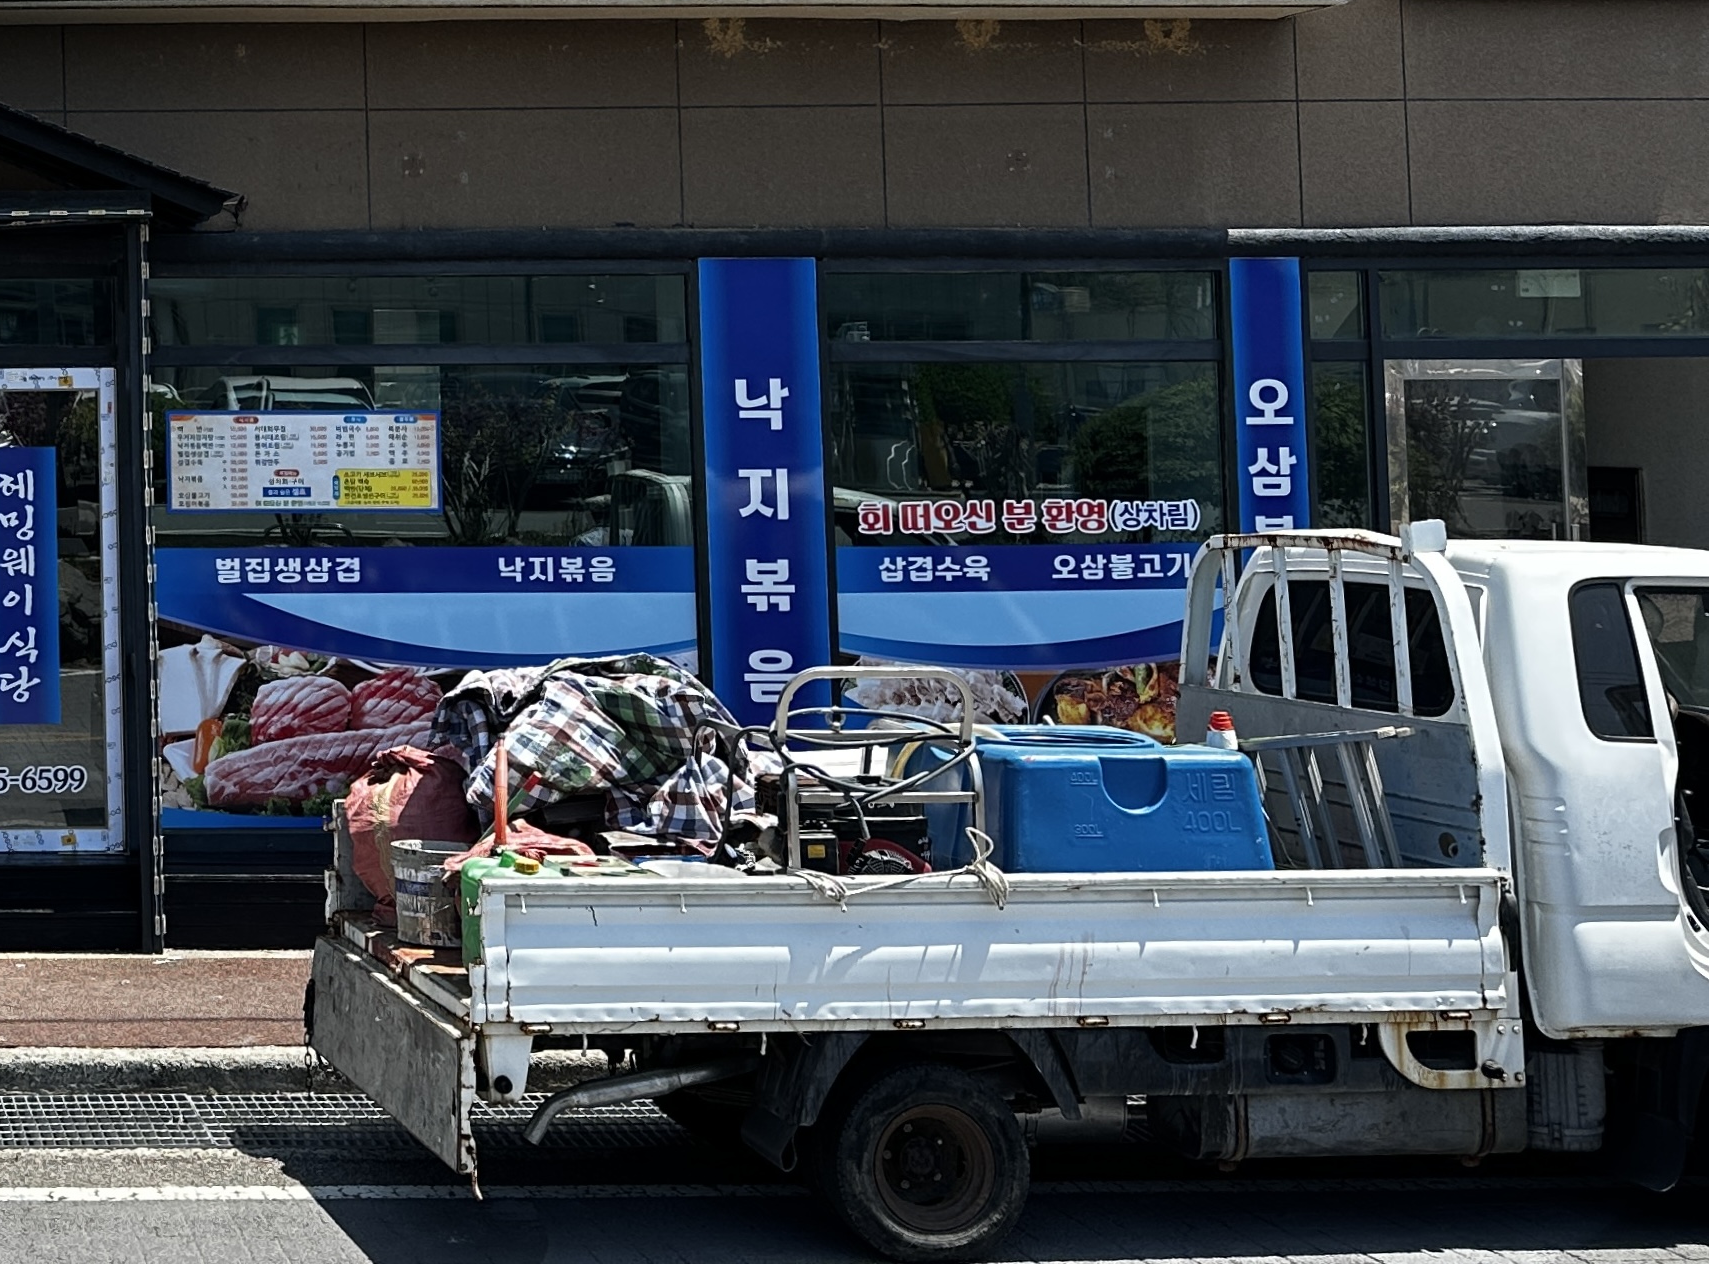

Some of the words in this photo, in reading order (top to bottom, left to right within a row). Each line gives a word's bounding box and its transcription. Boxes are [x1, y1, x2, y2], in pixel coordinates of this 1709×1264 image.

[858, 499, 893, 534] 회
[898, 499, 996, 534] 떠오신
[1002, 499, 1037, 534] 분
[734, 378, 797, 703] 낙지볶음
[215, 556, 361, 583] 벌집생삼겹
[498, 556, 616, 583] 낙지볶음
[1051, 553, 1191, 580] 오삼불고기
[1182, 811, 1243, 834] 400L
